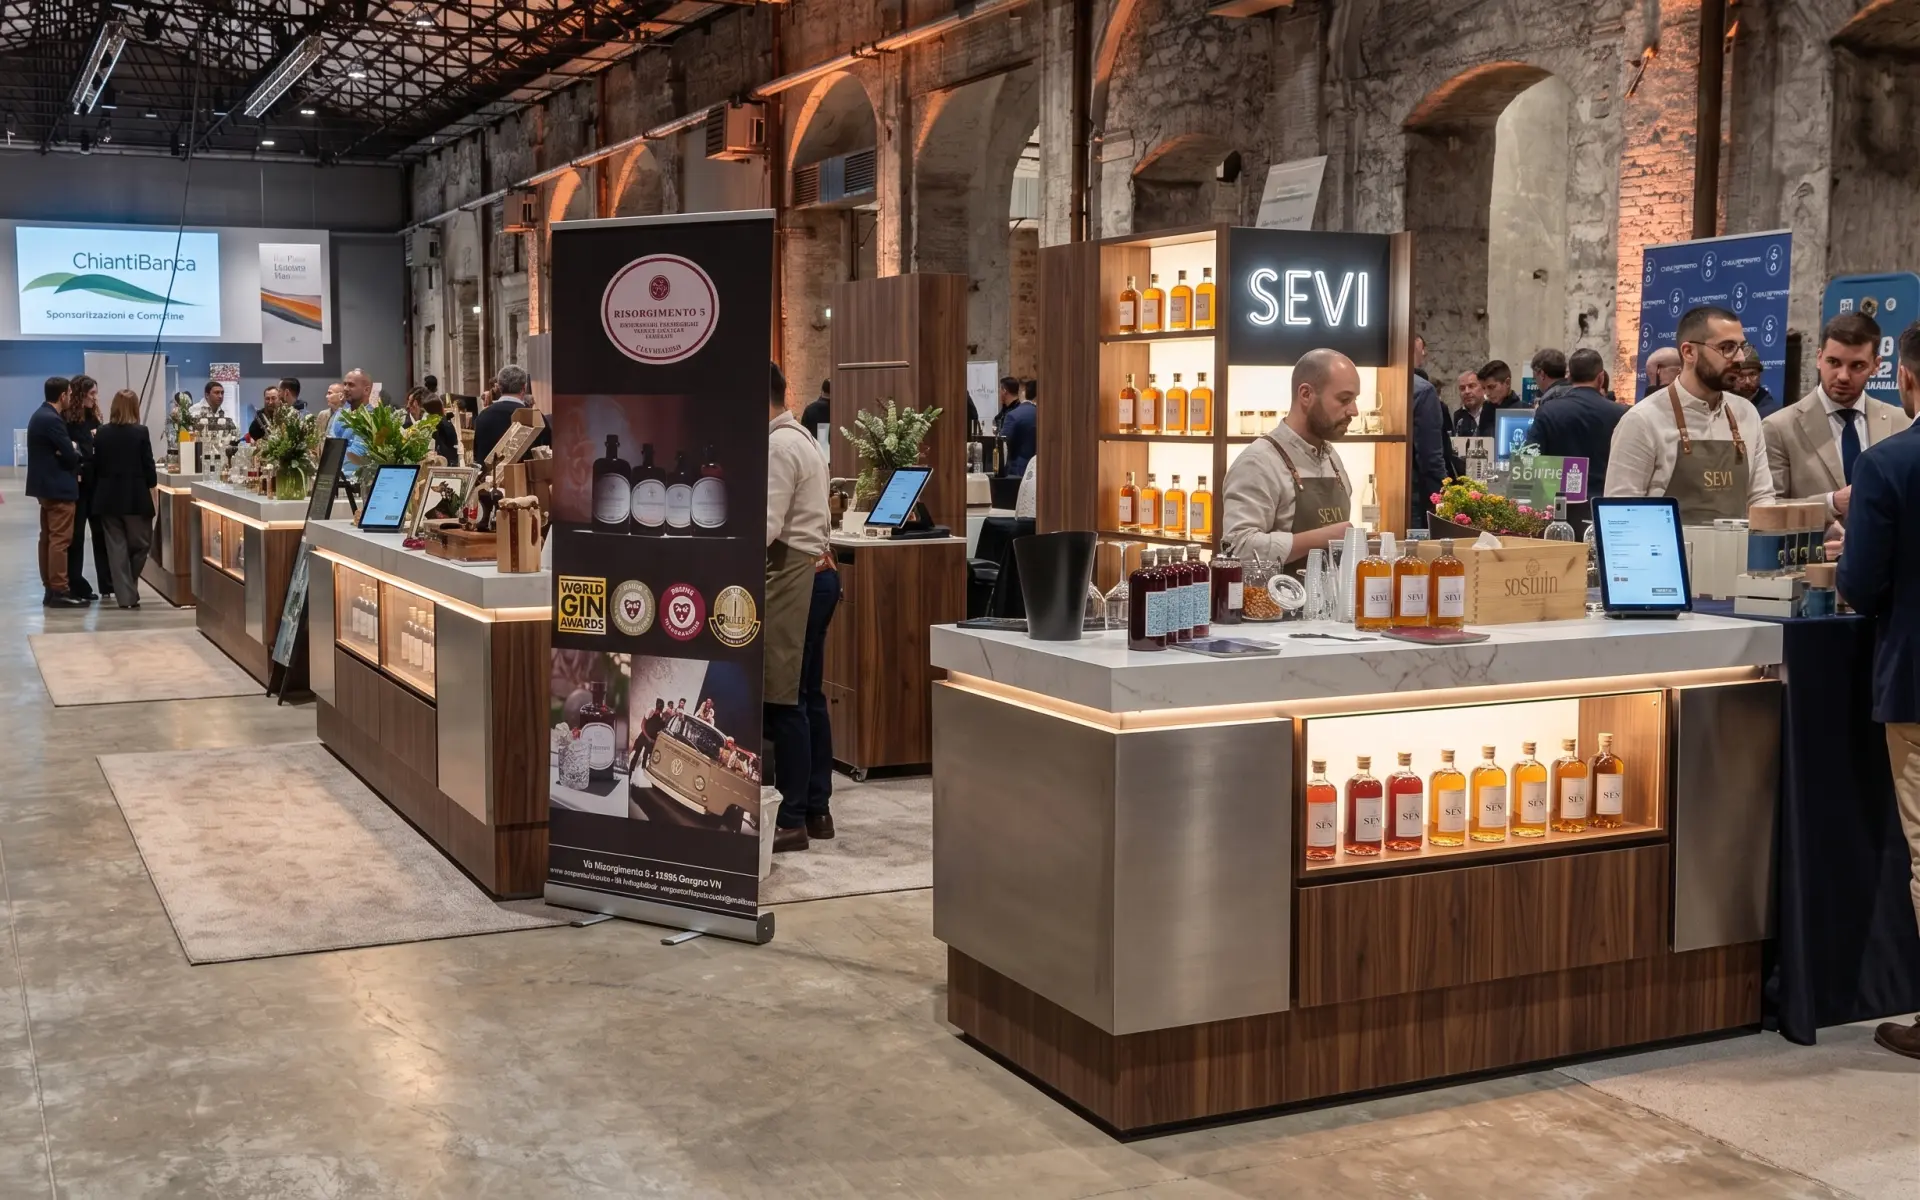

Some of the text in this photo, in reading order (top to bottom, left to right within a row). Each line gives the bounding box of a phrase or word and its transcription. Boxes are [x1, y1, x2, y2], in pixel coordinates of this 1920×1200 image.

[73, 252, 196, 272] ChiantiBanca
[1247, 267, 1369, 327] SEVI
[614, 308, 706, 319] RISORGIMENTO 5
[1703, 470, 1734, 487] SEVI
[1318, 506, 1344, 524] SEVI
[560, 581, 605, 595] WORLD
[1407, 593, 1424, 601] SEVI
[560, 594, 604, 618] GIN
[560, 617, 604, 630] AWARDS
